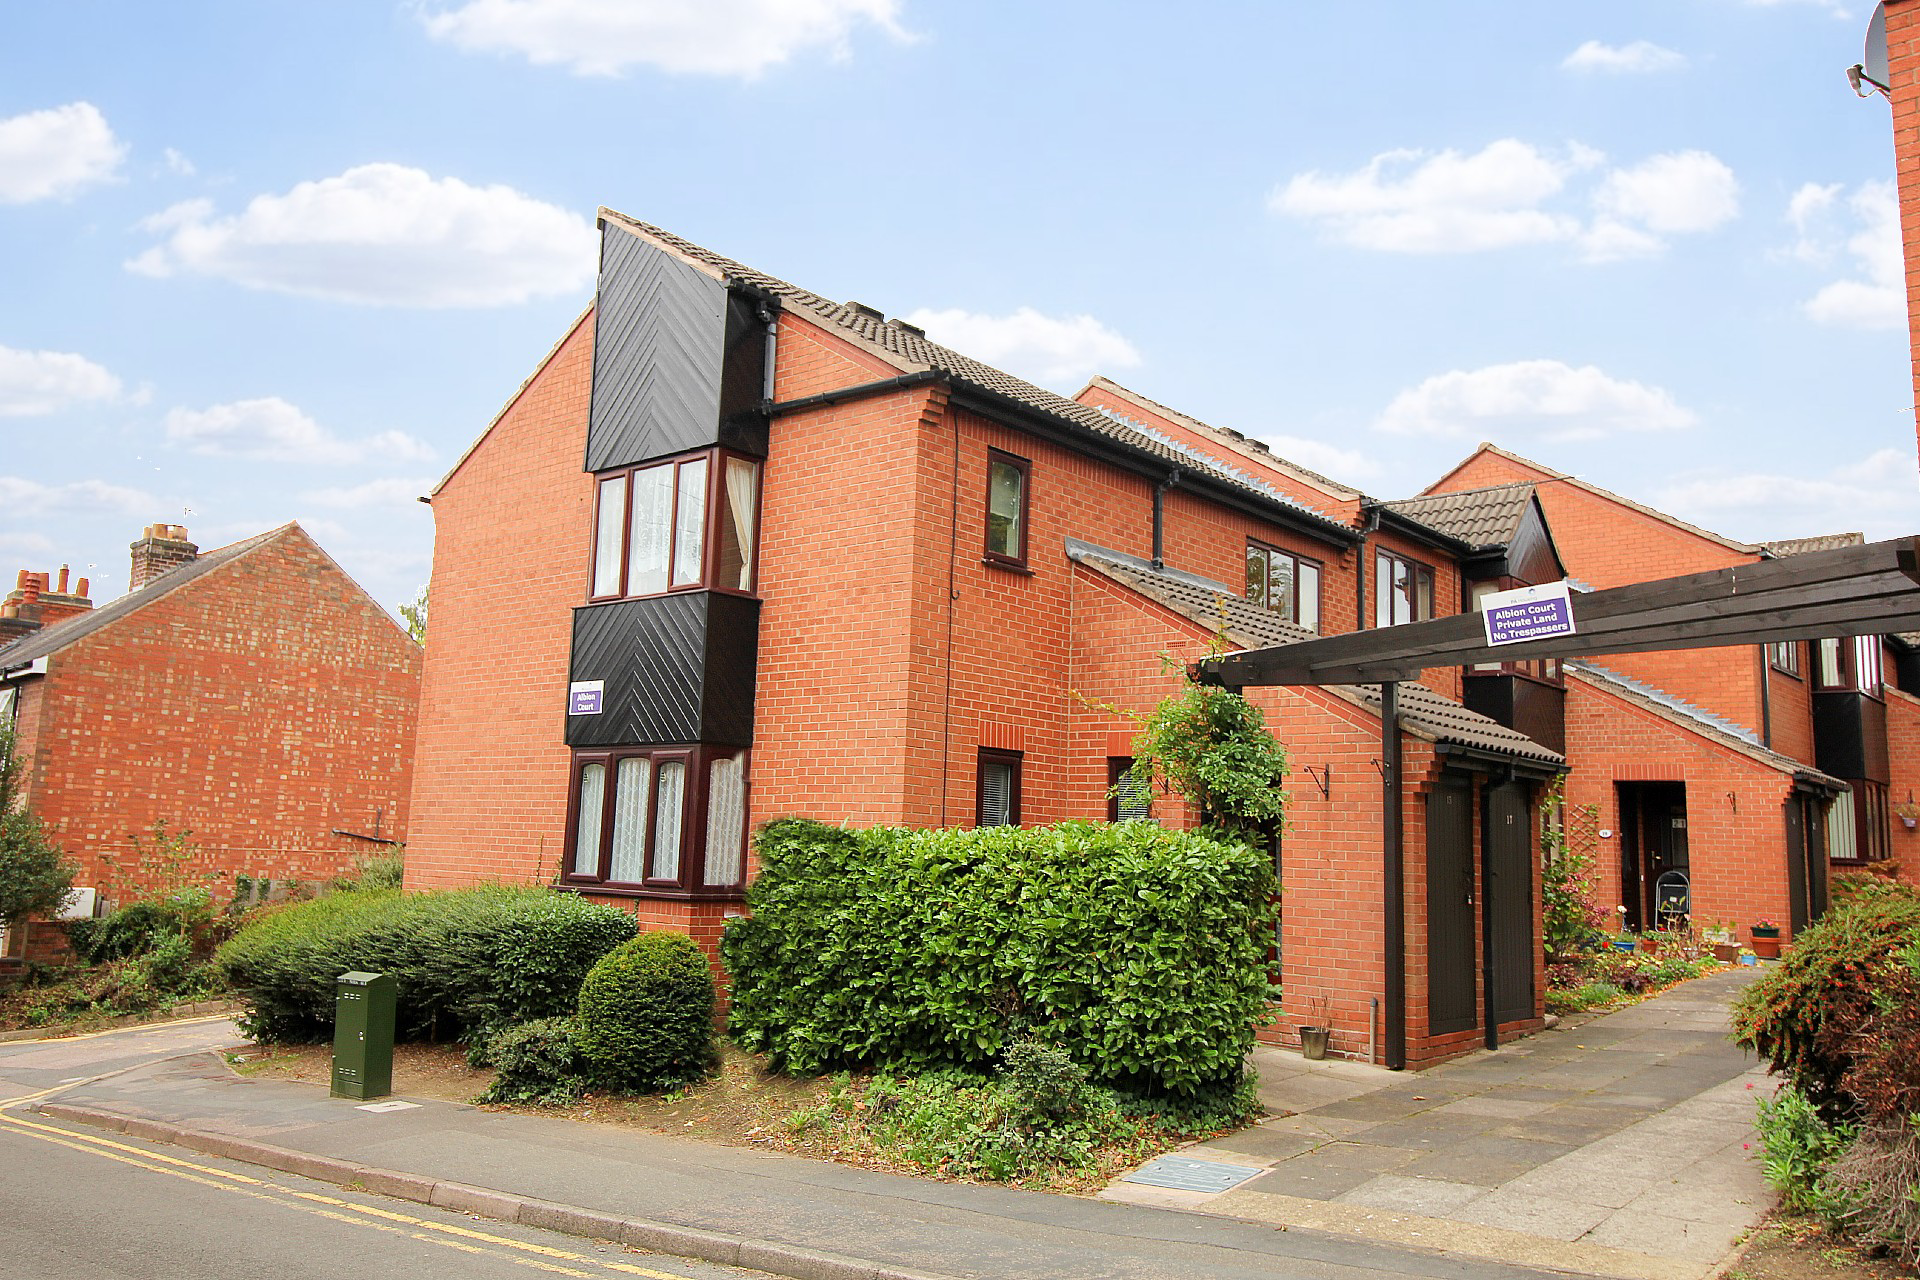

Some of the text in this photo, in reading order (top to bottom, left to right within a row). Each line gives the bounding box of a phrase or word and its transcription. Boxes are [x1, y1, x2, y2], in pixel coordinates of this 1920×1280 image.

[1495, 603, 1556, 620] Albion Court
[1496, 612, 1558, 630] Private Land
[1493, 623, 1568, 641] No Trespassers
[577, 693, 596, 702] Albion
[577, 703, 594, 711] Court
[1673, 820, 1685, 828] 21
